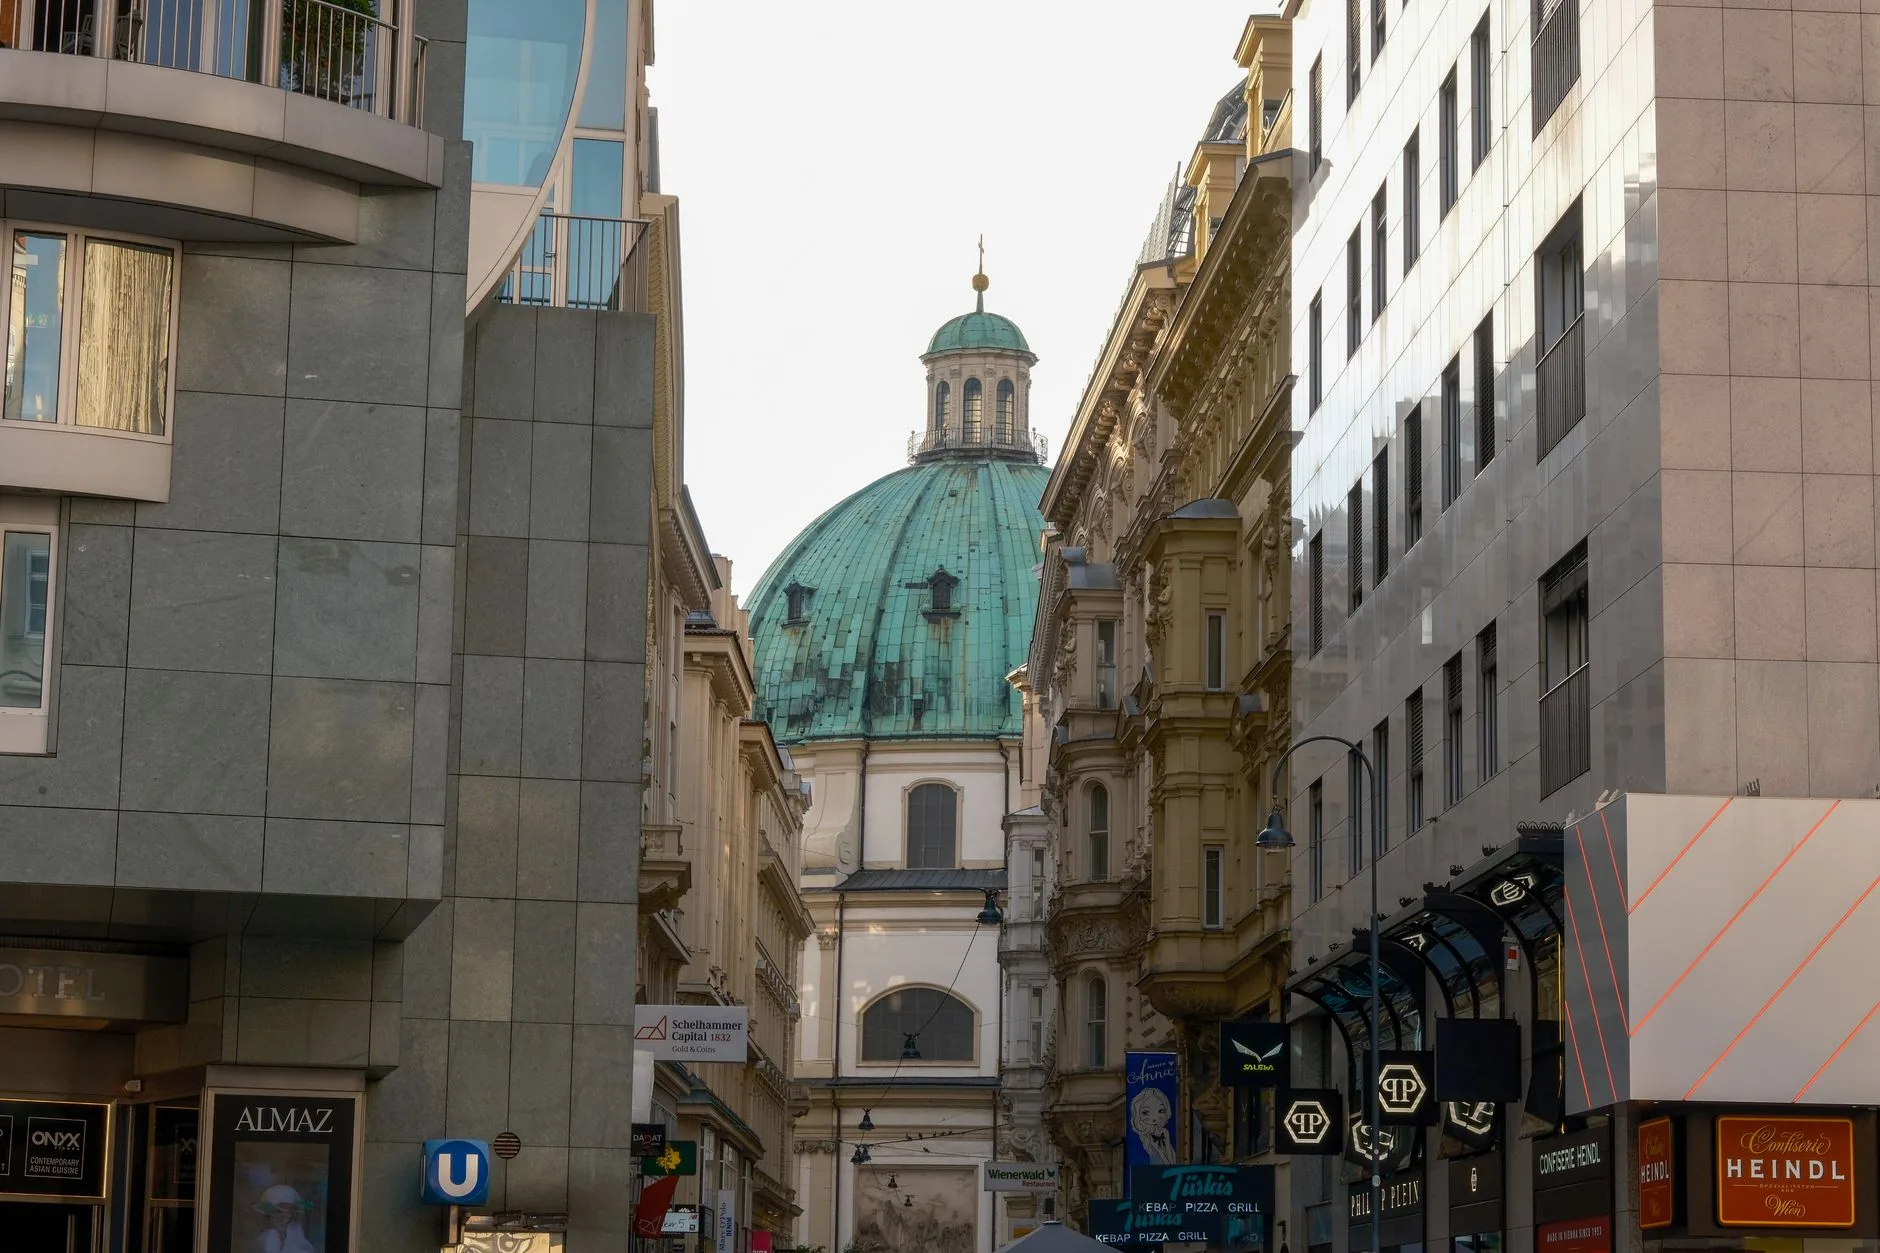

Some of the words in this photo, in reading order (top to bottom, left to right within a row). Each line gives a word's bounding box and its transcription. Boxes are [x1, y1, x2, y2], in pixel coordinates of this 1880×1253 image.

[672, 1019, 743, 1030] Schelhammer
[672, 1031, 707, 1043] Capital
[711, 1033, 731, 1042] 1832
[696, 1046, 716, 1054] Coins
[1127, 1058, 1176, 1085] Anna
[1242, 1063, 1275, 1071] SALEWA
[233, 1106, 334, 1133] ALMAZ
[32, 1131, 81, 1148] ONYX
[1740, 1125, 1831, 1155] Confiserie
[30, 1156, 80, 1167] CONTEMPORARY
[1540, 1147, 1576, 1175] CONFISERIE
[1577, 1141, 1601, 1167] HEINDL
[29, 1165, 51, 1173] ASIAN
[52, 1166, 79, 1175] CUISINE
[438, 1153, 479, 1197] U
[988, 1168, 1045, 1180] Wienerwald
[1640, 1160, 1669, 1184] HEINDL
[1727, 1158, 1845, 1180] HEINDL
[1160, 1165, 1239, 1202] Türkis
[1138, 1203, 1176, 1213] KEBAP
[1185, 1202, 1219, 1213] PIZZA
[1228, 1202, 1262, 1213] GRILL
[1351, 1188, 1386, 1217] PHILP
[1391, 1180, 1419, 1209] PLEIN
[1765, 1194, 1806, 1217] Wien
[1095, 1233, 1131, 1243] KEBAP
[1139, 1232, 1170, 1242] PIZZA
[1178, 1231, 1209, 1241] GRILL
